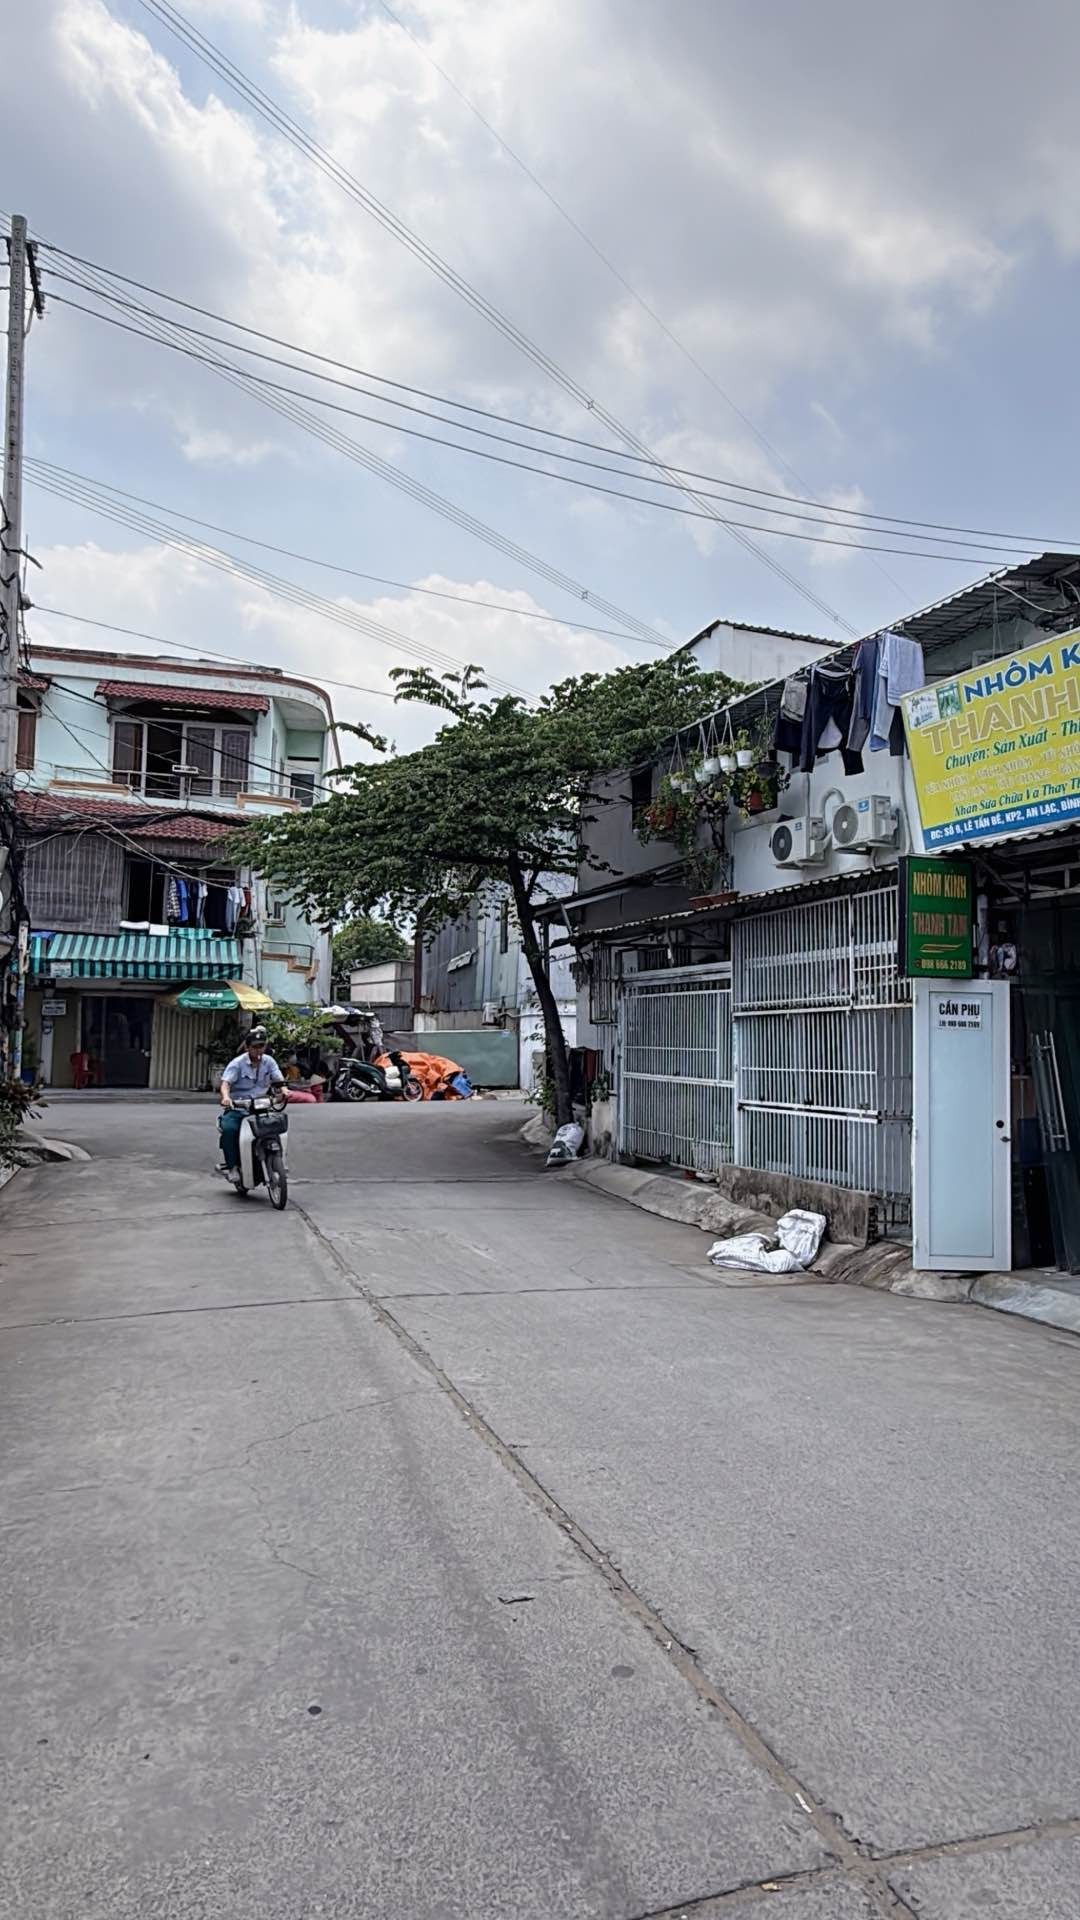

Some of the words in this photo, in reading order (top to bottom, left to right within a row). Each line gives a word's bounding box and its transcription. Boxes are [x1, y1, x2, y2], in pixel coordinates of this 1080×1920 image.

[963, 655, 1053, 703] NHÔM
[1061, 643, 1080, 669] K
[920, 676, 1080, 756] THANH
[1026, 806, 1039, 818] AN
[913, 867, 942, 897] NHÔM
[912, 911, 945, 936] THANH
